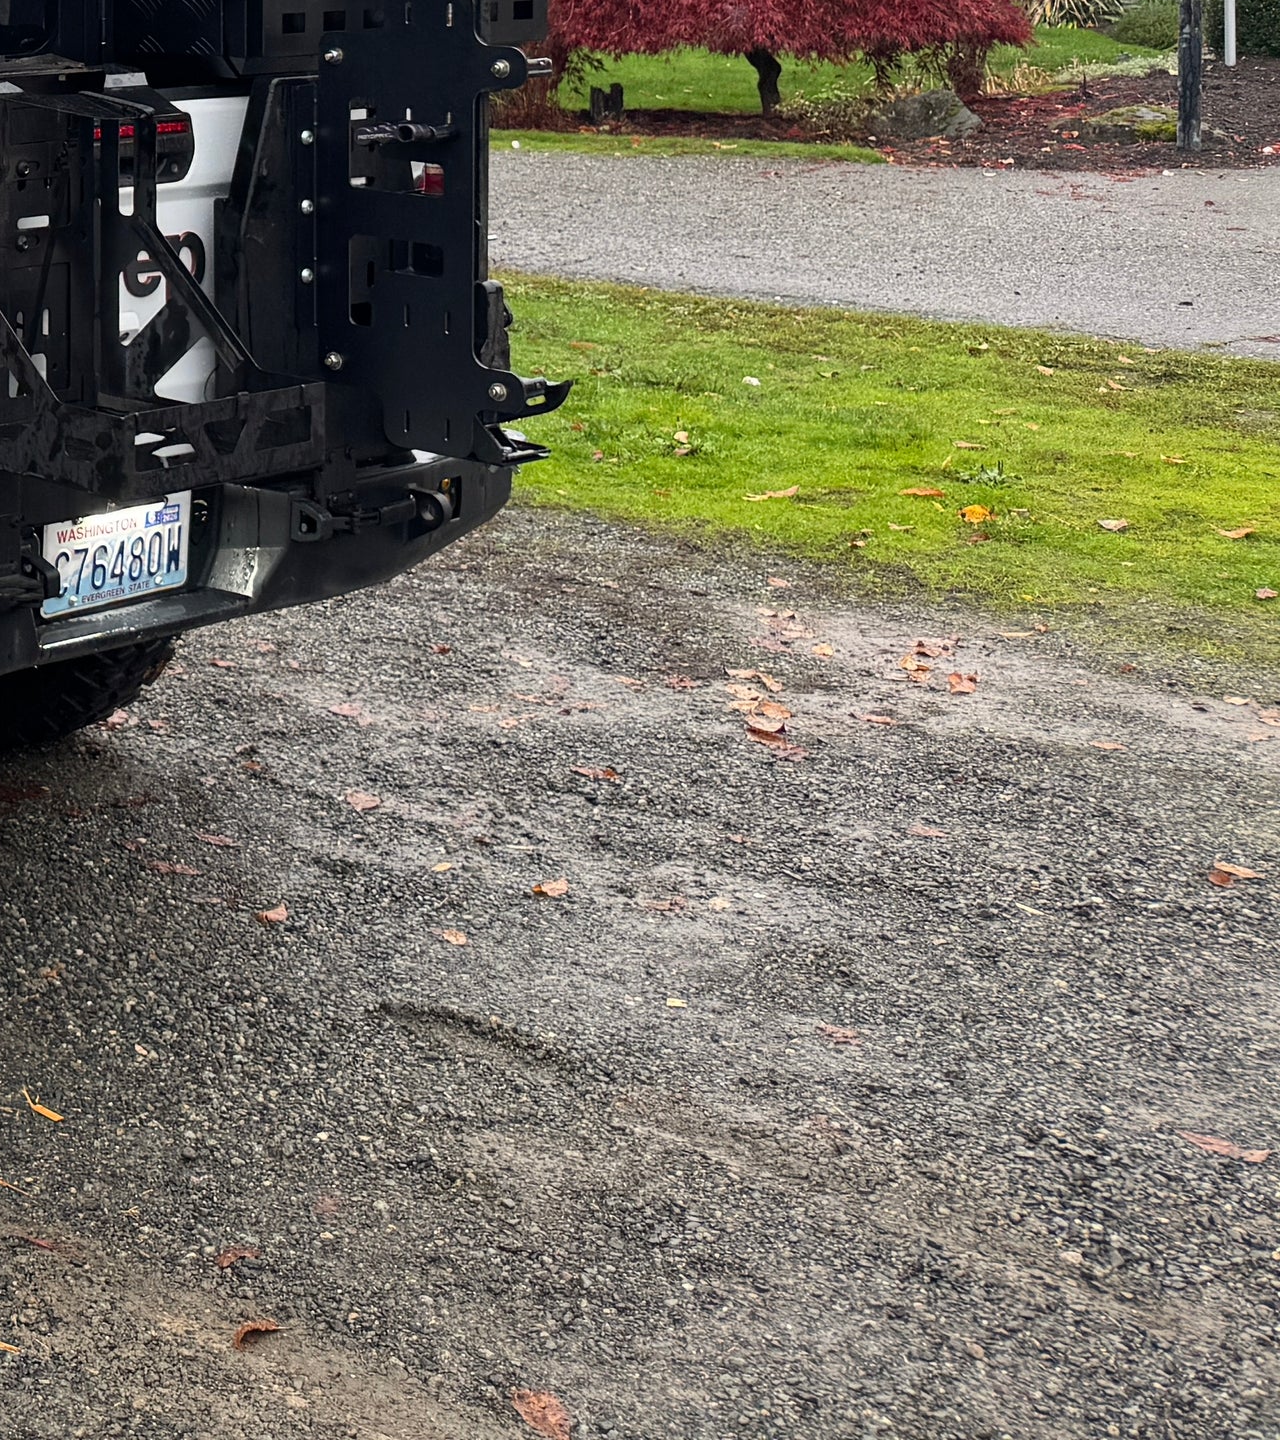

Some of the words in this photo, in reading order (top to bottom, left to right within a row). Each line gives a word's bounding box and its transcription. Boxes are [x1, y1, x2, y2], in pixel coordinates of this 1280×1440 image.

[123, 231, 207, 302] ep
[56, 518, 138, 544] WASHINGTON
[55, 525, 182, 598] C76480W
[81, 587, 126, 603] EVERGREEN
[128, 580, 151, 592] STATE
